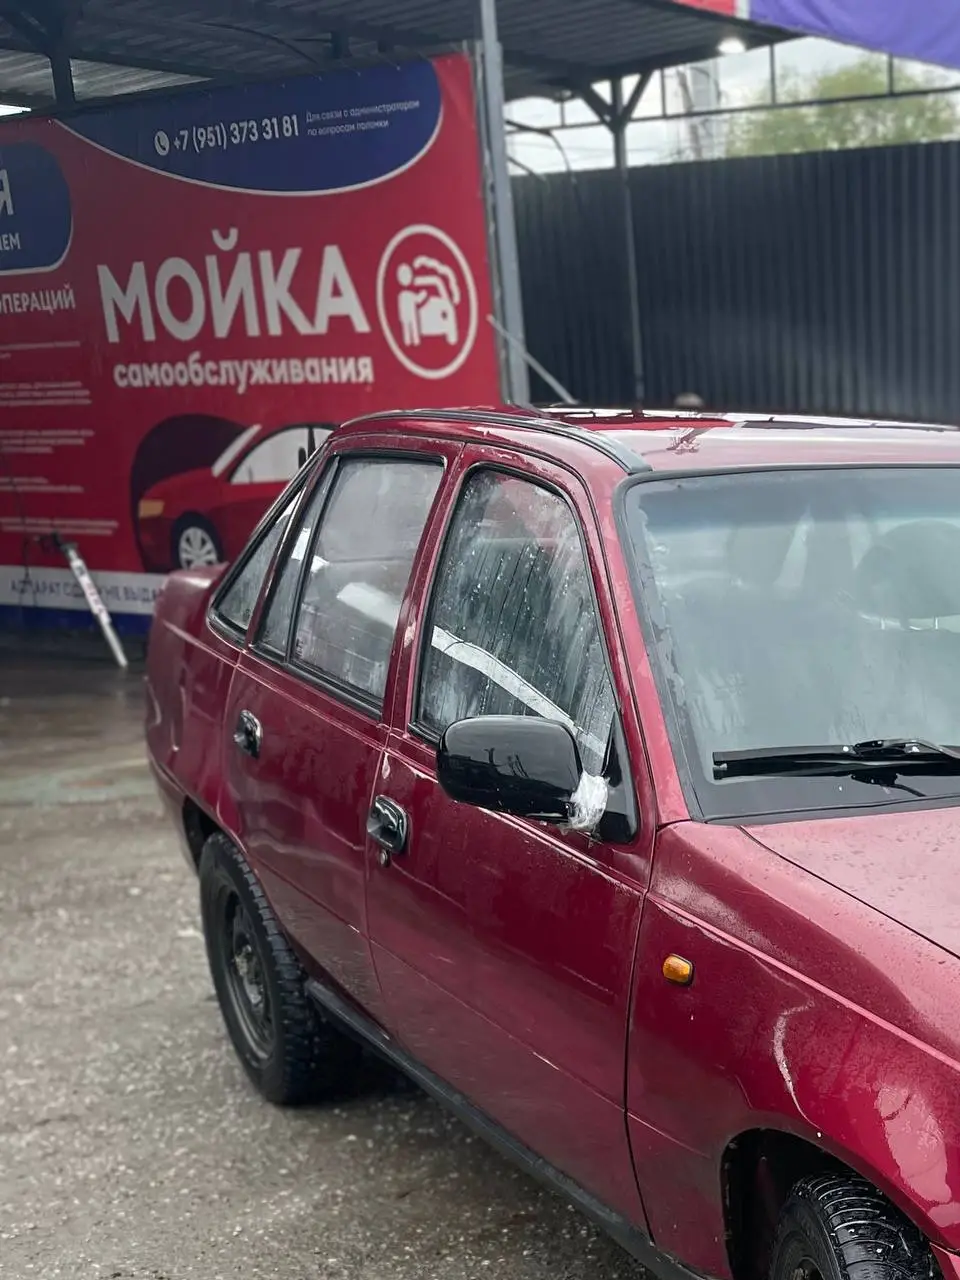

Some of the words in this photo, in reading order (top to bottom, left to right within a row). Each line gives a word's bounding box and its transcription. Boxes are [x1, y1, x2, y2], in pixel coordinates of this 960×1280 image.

[174, 129, 190, 151] +7
[193, 122, 227, 153] (951)
[230, 119, 258, 145] 373
[262, 116, 281, 141] 31
[283, 114, 300, 137] 81
[0, 232, 21, 251] ЕМ
[0, 282, 76, 315] ПЕРАЦИЙ
[97, 227, 372, 343] МОЙКА
[113, 351, 375, 395] самообслуживания
